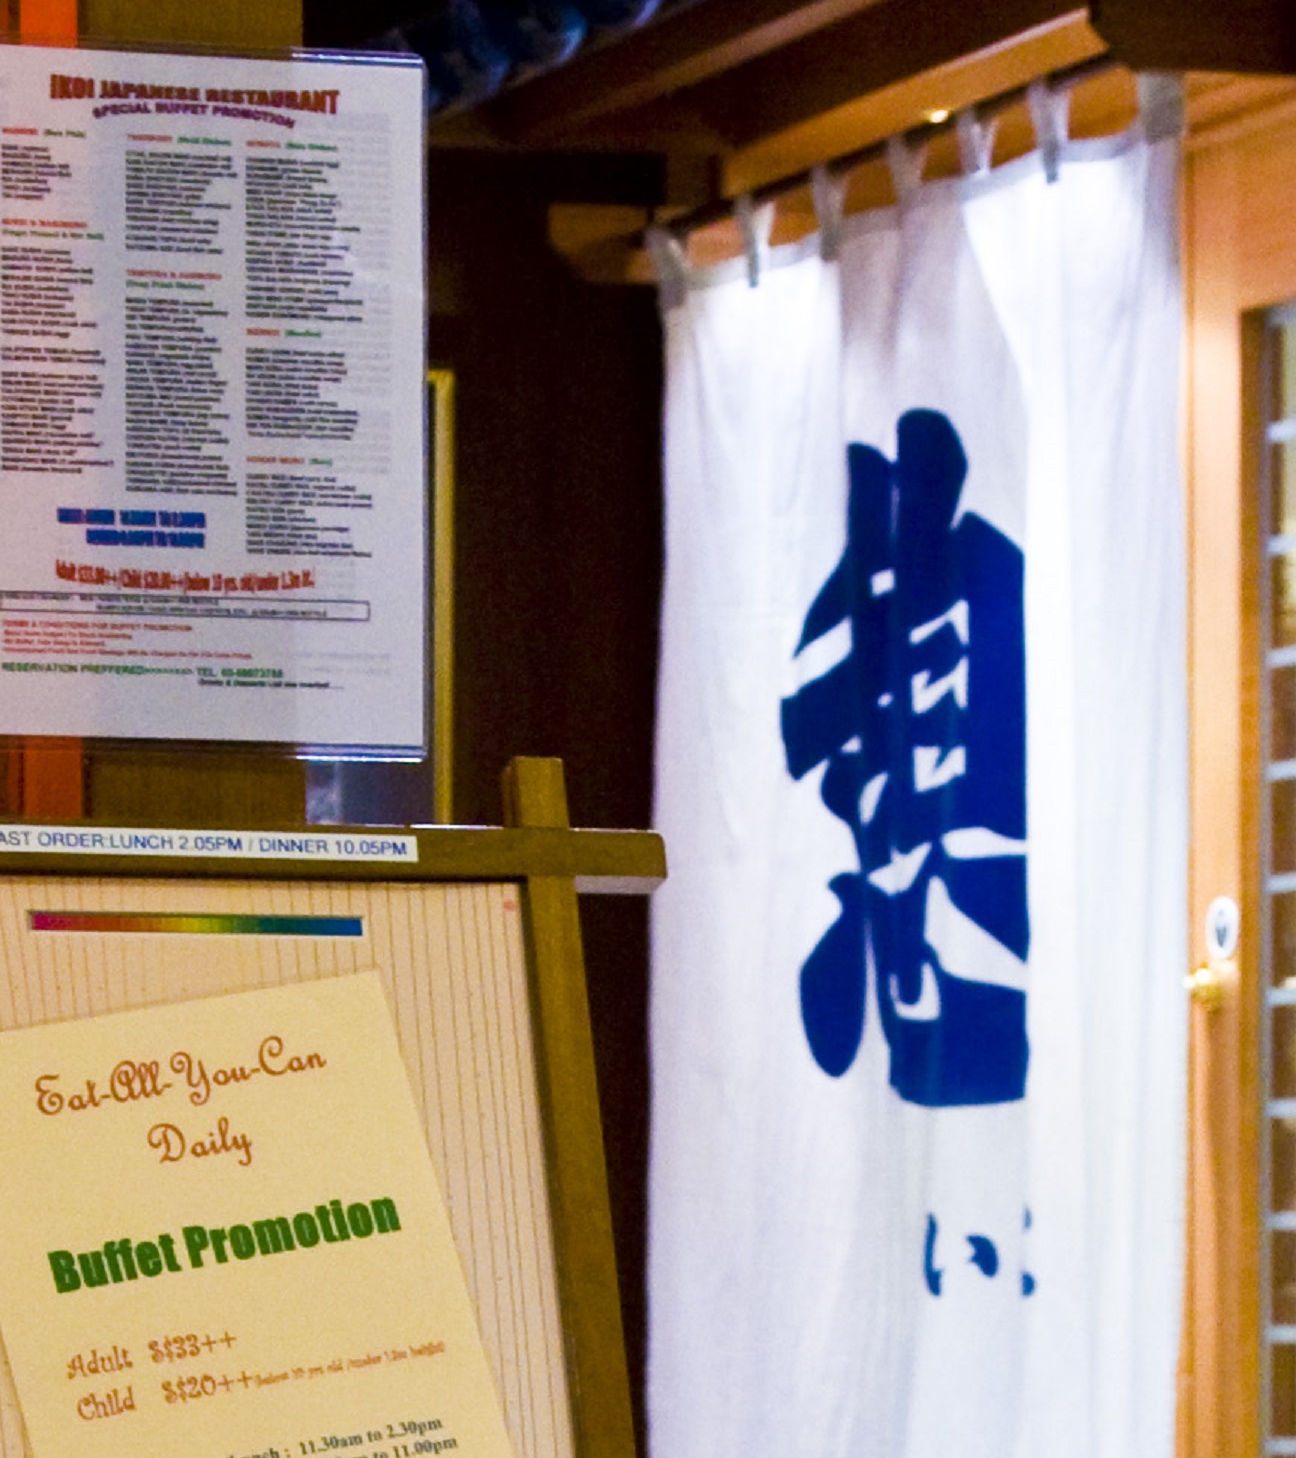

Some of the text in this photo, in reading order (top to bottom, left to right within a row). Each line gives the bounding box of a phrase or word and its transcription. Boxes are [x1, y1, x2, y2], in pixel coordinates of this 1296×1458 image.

[50, 74, 340, 114] IKOI JAPANESE RESTAURANT
[92, 102, 152, 119] SPECIAL
[212, 105, 296, 129] PROMOTION
[179, 835, 243, 853] 2.05PM
[259, 837, 329, 855] DINNER
[335, 839, 408, 857] 10.05PM
[35, 1035, 326, 1116] Eat-All-You-Can
[147, 1116, 253, 1166] Daily
[48, 1196, 402, 1294] Buffet Promotion
[66, 1345, 134, 1380] Adult
[77, 1385, 138, 1422] Child
[299, 1432, 364, 1457] 11.30am
[367, 1428, 383, 1443] to
[387, 1418, 443, 1439] 2.30pm
